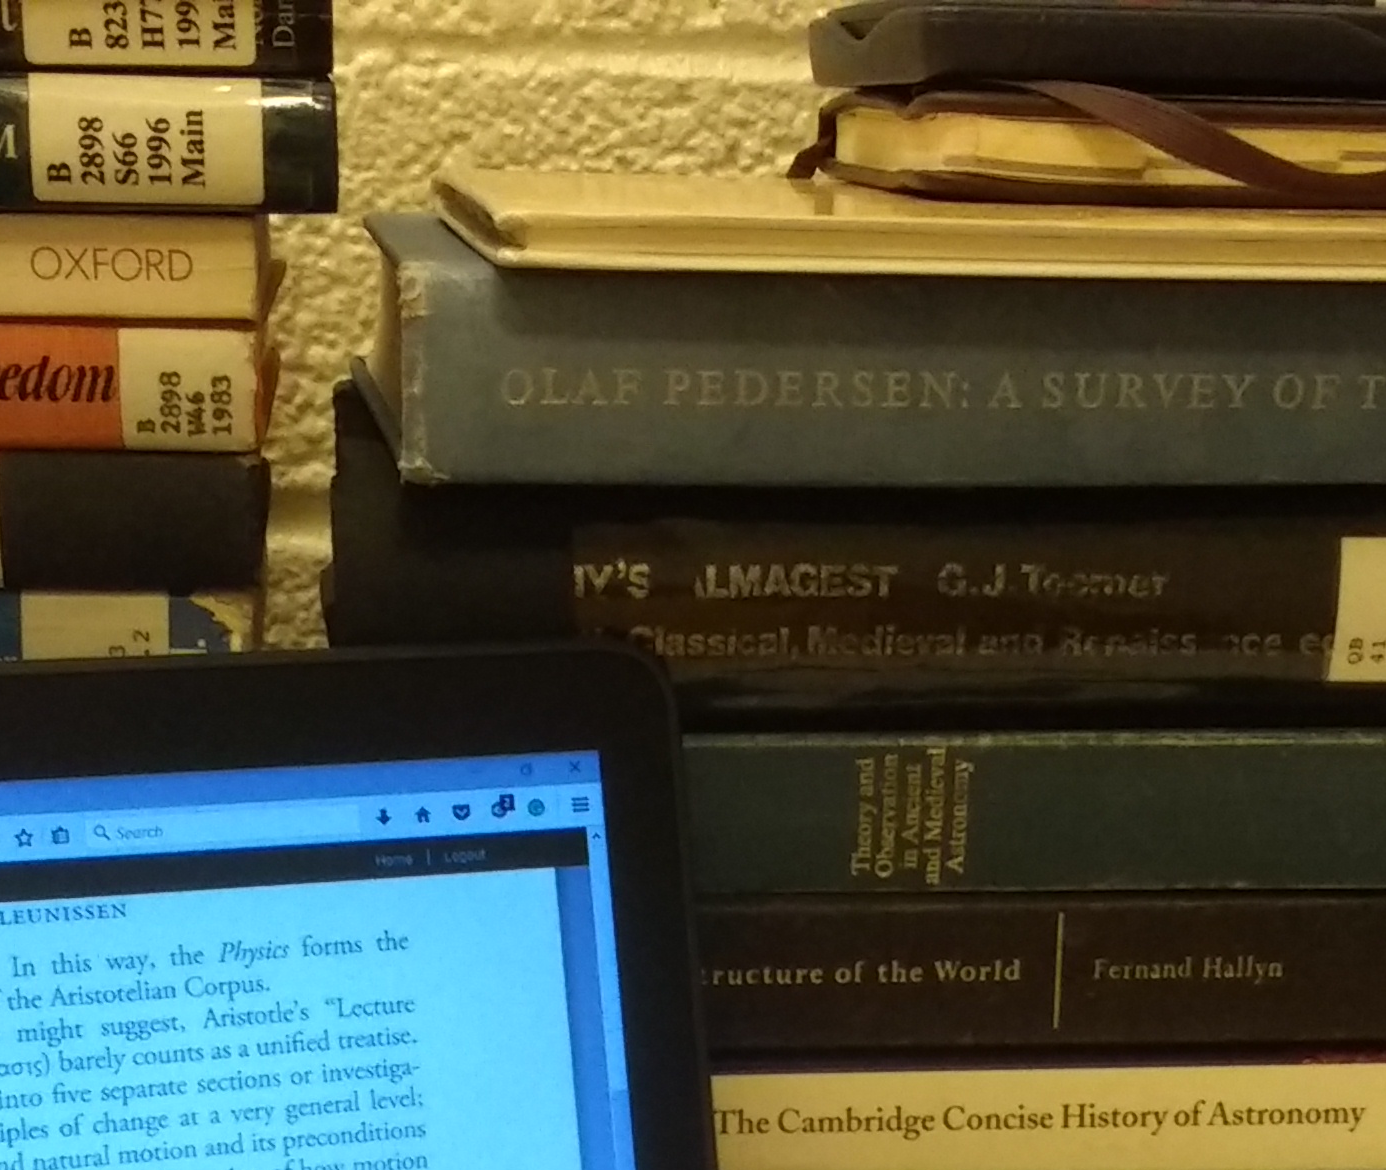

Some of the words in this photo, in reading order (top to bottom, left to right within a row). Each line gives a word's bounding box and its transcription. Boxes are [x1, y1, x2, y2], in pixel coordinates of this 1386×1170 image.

[68, 27, 92, 49] B
[104, 1, 130, 49] 823
[78, 116, 106, 186] 2898
[113, 132, 139, 186] S66
[146, 117, 173, 186] 1996
[180, 109, 206, 189] Main
[47, 162, 72, 184] B
[29, 246, 194, 282] OXFORD
[161, 371, 181, 434] 2898
[213, 375, 232, 436] 1983
[500, 368, 641, 408] OLAF
[663, 369, 970, 410] PEDERSEN:
[988, 372, 1021, 408] A
[1042, 372, 1253, 410] SURVEY
[1272, 374, 1341, 410] OF
[137, 419, 155, 434] B
[1348, 637, 1364, 664] QB
[856, 757, 875, 797] and
[926, 746, 946, 846] Medieval
[116, 823, 164, 841] Search
[874, 754, 898, 878] Observation
[945, 759, 974, 874] Astronomy
[851, 803, 877, 876] Theory
[926, 849, 941, 885] and
[12, 956, 36, 979] In
[52, 952, 92, 975] this
[106, 952, 155, 975] way,
[170, 944, 204, 967] the
[219, 939, 290, 968] Physics
[301, 934, 362, 959] forms
[376, 930, 409, 953] the
[702, 962, 822, 986] tructure
[835, 961, 865, 984] of
[878, 961, 923, 983] the
[934, 960, 1021, 983] World
[1092, 956, 1192, 981] Fernand
[1203, 955, 1284, 986] Hallyn
[8, 988, 42, 1011] the
[50, 981, 176, 1009] Aristotelian
[185, 976, 271, 1004] Corpus.
[17, 1019, 83, 1047] might
[100, 1014, 186, 1042] suggest,
[714, 1108, 770, 1136] The
[777, 1104, 935, 1140] Cambridge
[943, 1105, 1053, 1131] Concise
[1061, 1103, 1169, 1137] History
[1174, 1101, 1207, 1128] of
[1211, 1100, 1367, 1132] Astronomy
